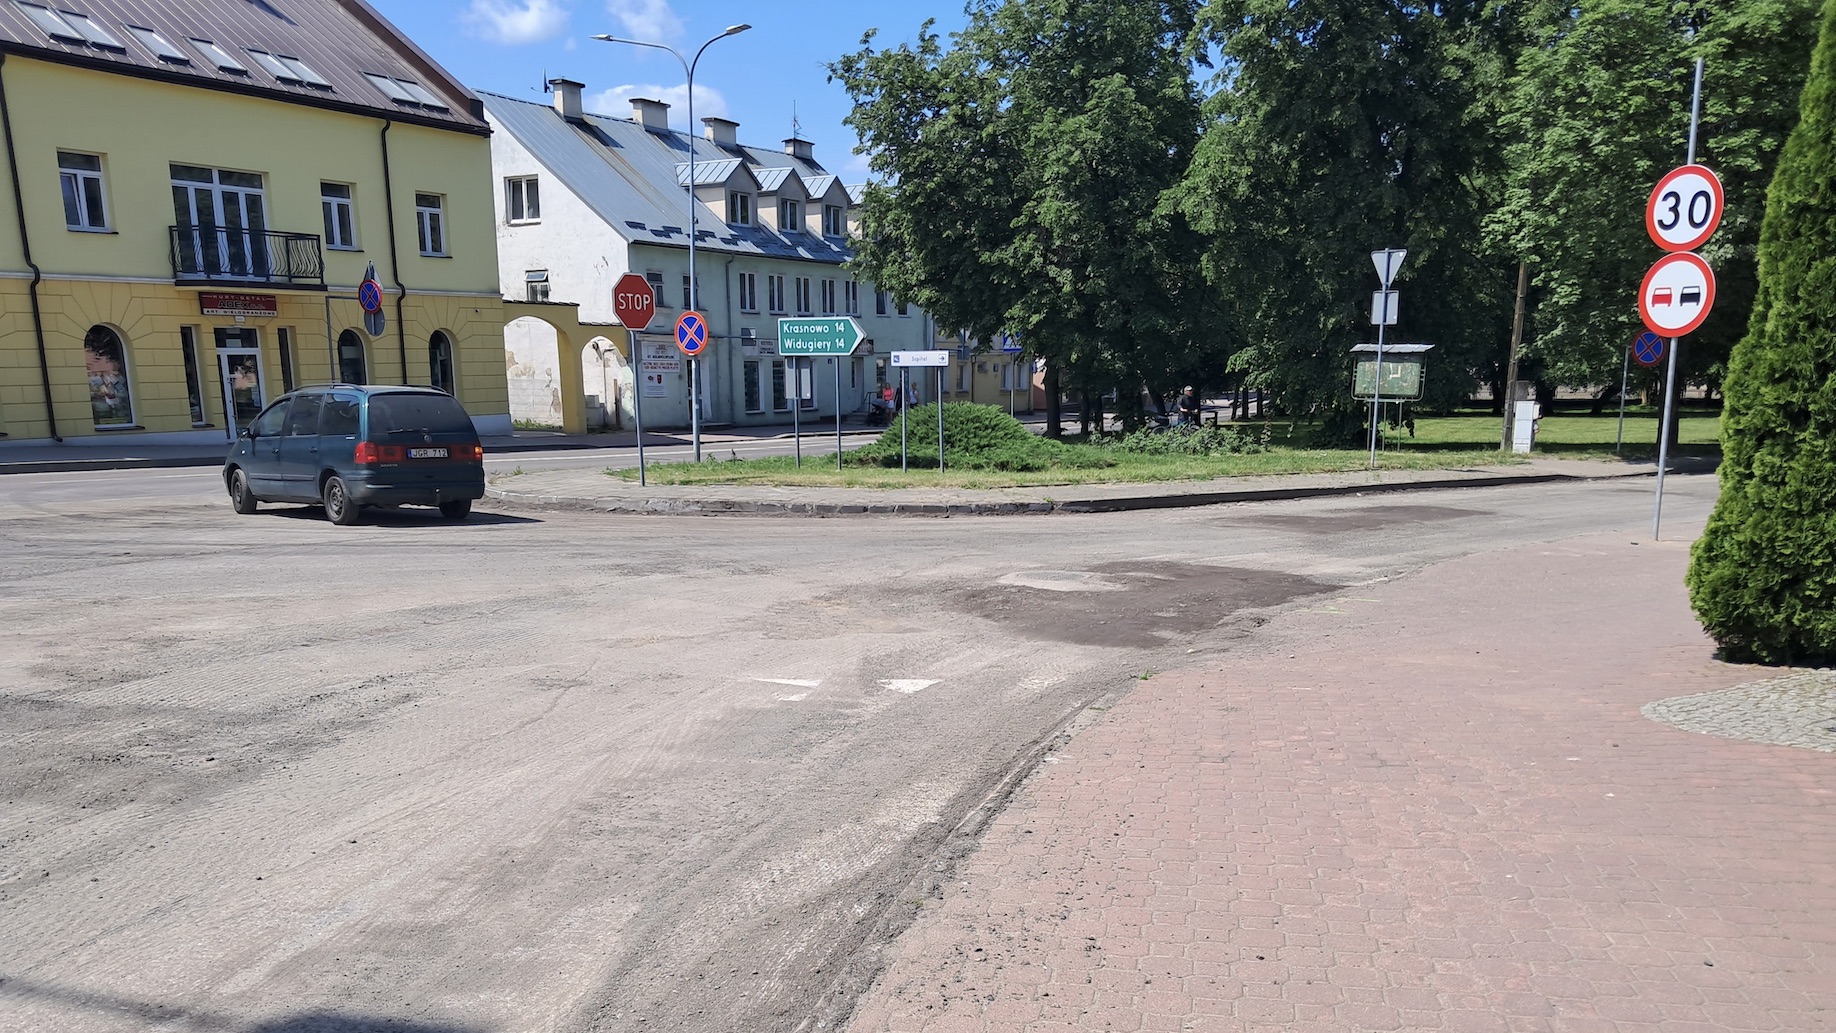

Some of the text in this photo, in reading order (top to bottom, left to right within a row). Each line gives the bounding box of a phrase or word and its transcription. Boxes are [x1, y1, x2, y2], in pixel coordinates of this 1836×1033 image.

[1657, 190, 1712, 231] 30
[218, 300, 250, 309] ADEX
[618, 293, 651, 311] STOP
[783, 322, 845, 334] Krasnowo 14
[784, 338, 831, 352] Widugiery
[835, 338, 845, 349] 14
[412, 449, 446, 457] JGR 712
